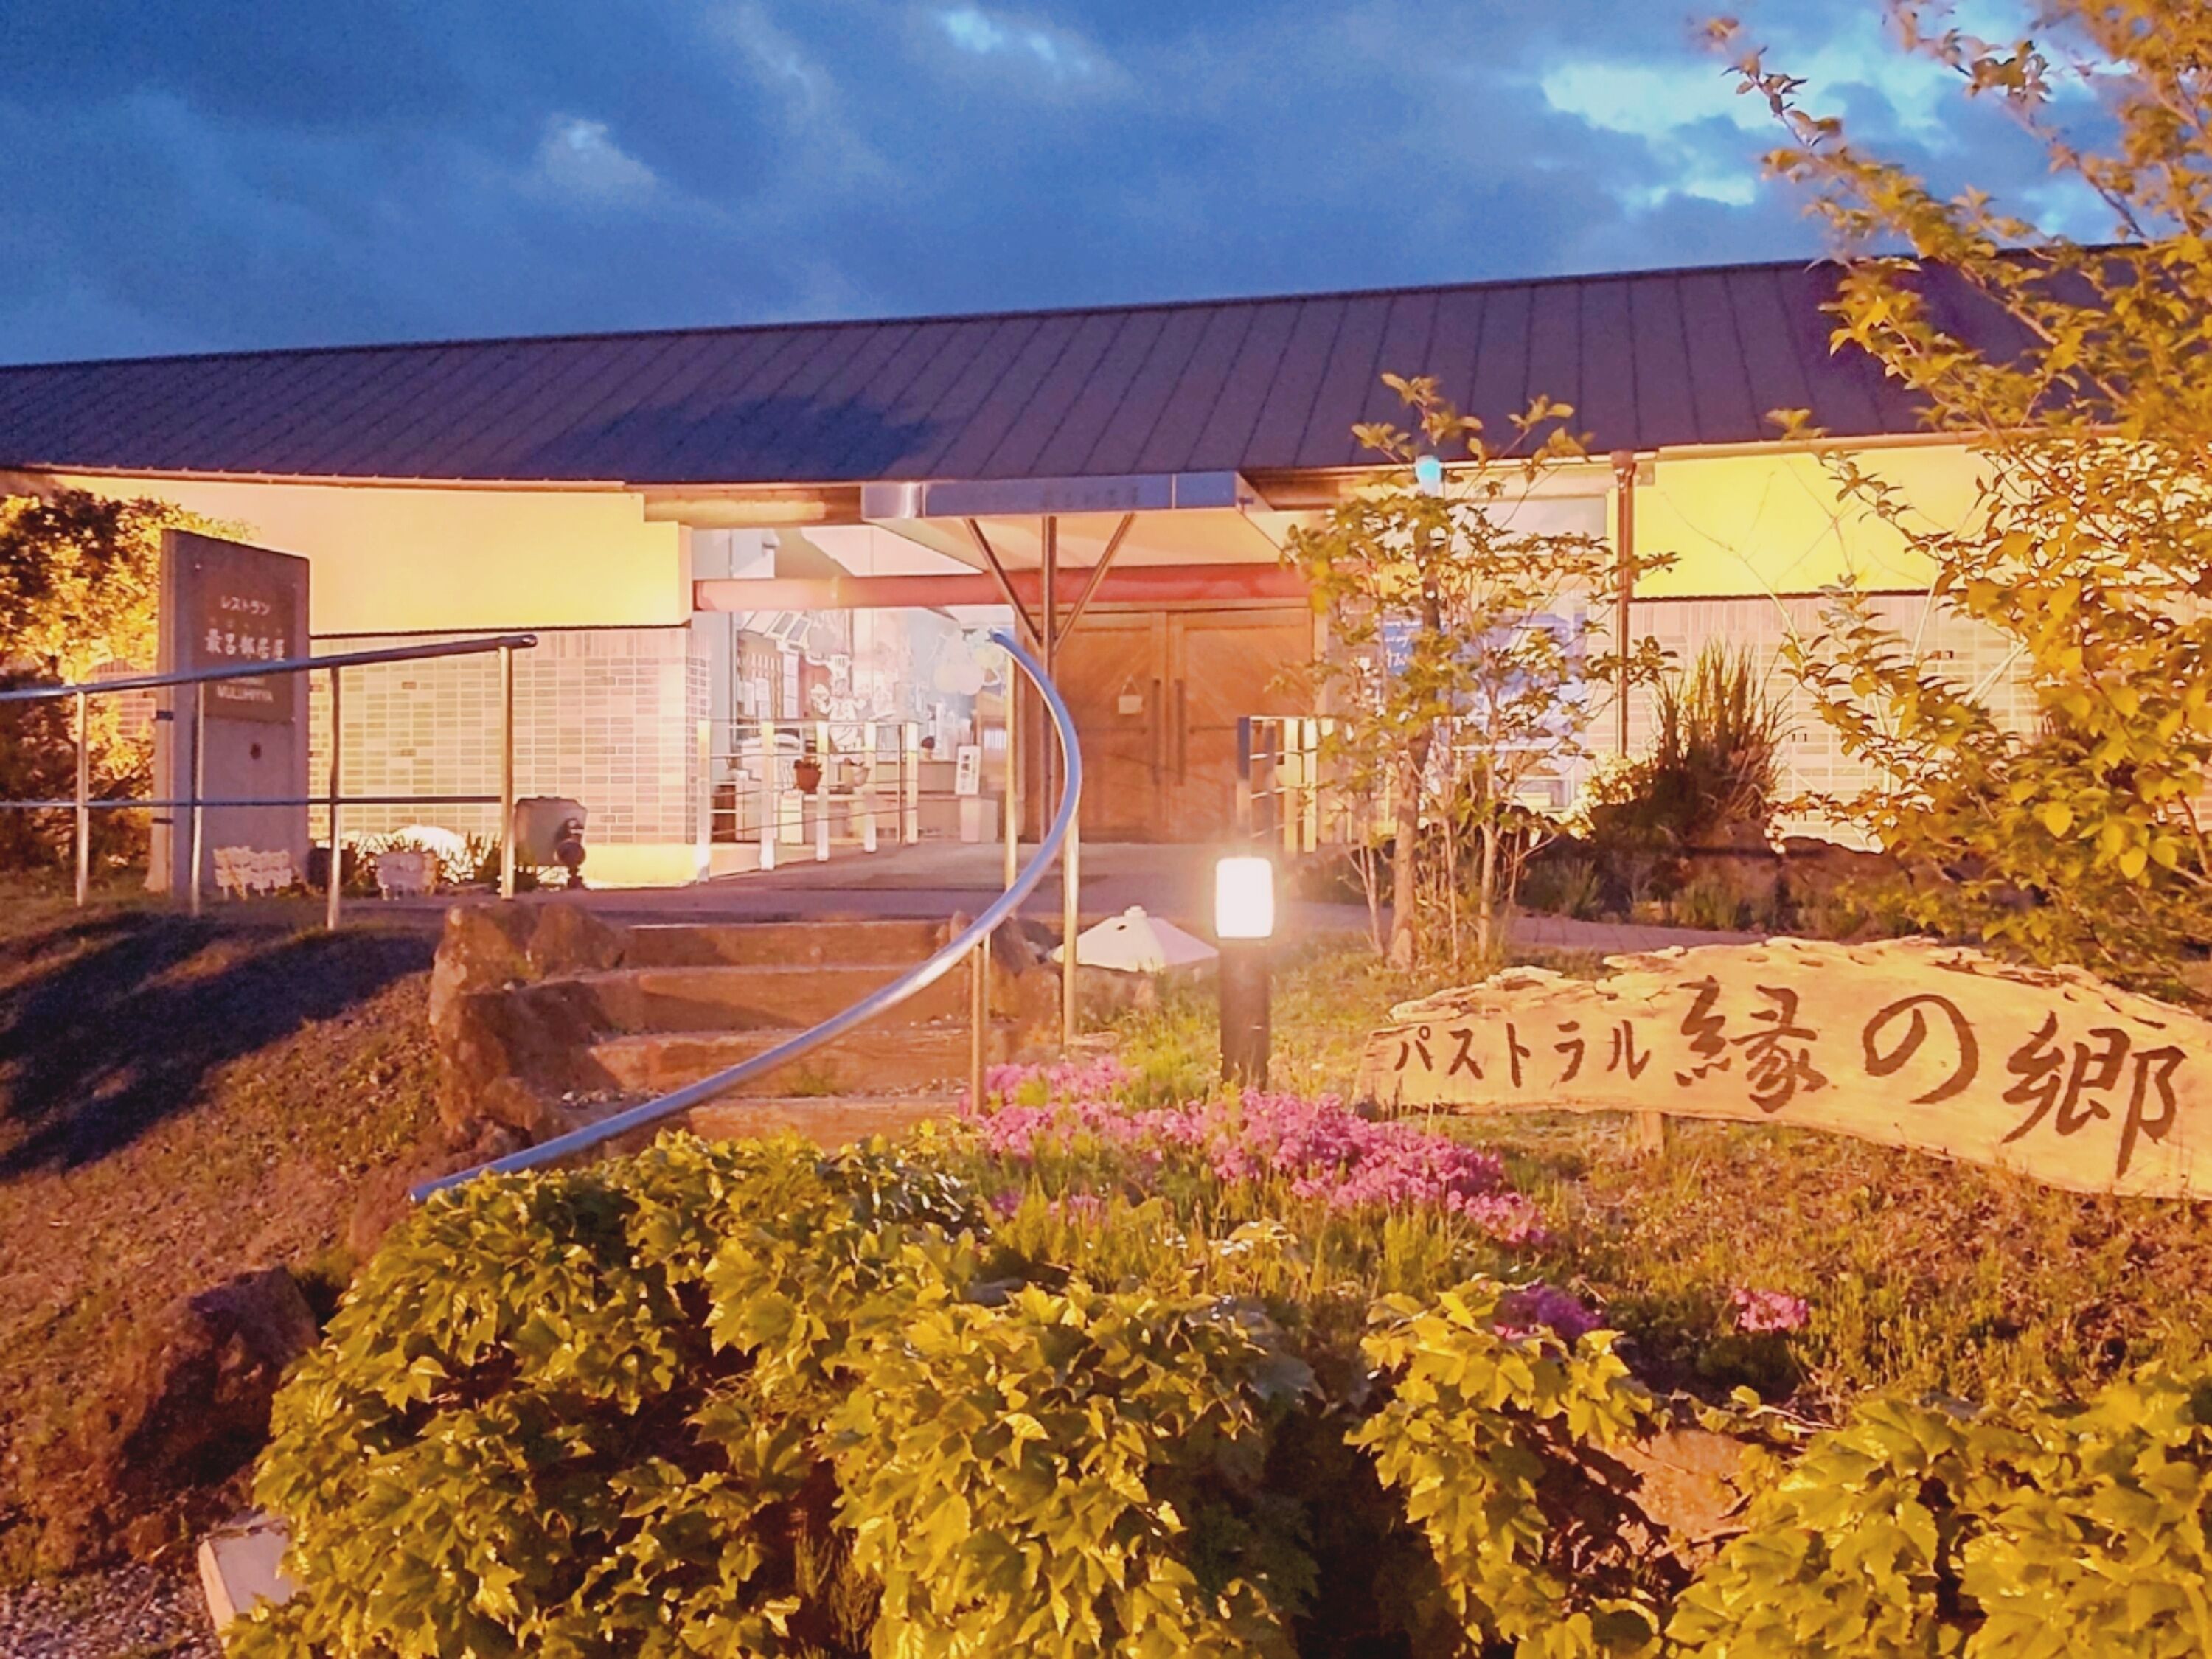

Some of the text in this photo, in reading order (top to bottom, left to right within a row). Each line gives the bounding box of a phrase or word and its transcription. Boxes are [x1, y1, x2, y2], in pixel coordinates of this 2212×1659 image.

[220, 595, 271, 616] レストラン
